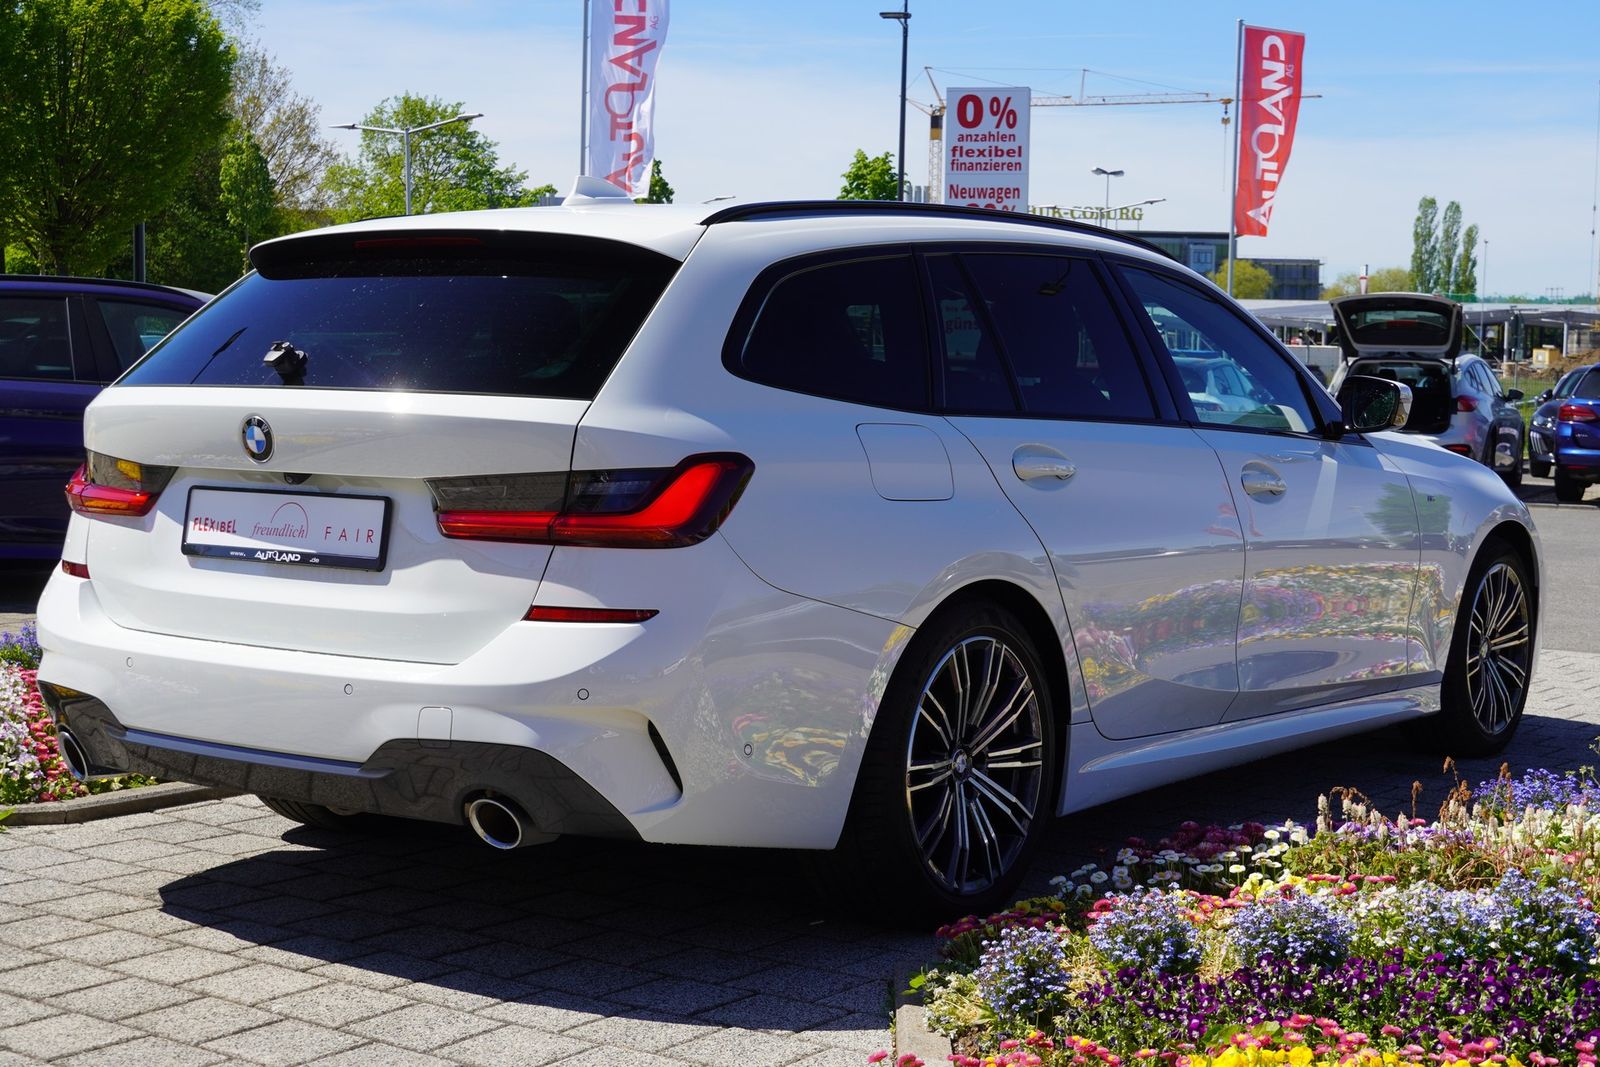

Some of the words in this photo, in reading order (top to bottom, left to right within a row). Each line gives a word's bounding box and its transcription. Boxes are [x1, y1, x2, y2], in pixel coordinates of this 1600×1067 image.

[650, 15, 659, 30] AG
[1285, 64, 1294, 78] AG
[958, 131, 1016, 143] anzahlen
[951, 145, 1022, 158] flexibel
[951, 159, 1022, 172] finanzieren
[949, 184, 1021, 203] Neuwagen
[192, 516, 237, 534] FLEXIBEL
[252, 523, 307, 538] freundlich
[324, 526, 374, 544] FAIR
[255, 550, 301, 562] AUTOLAND
